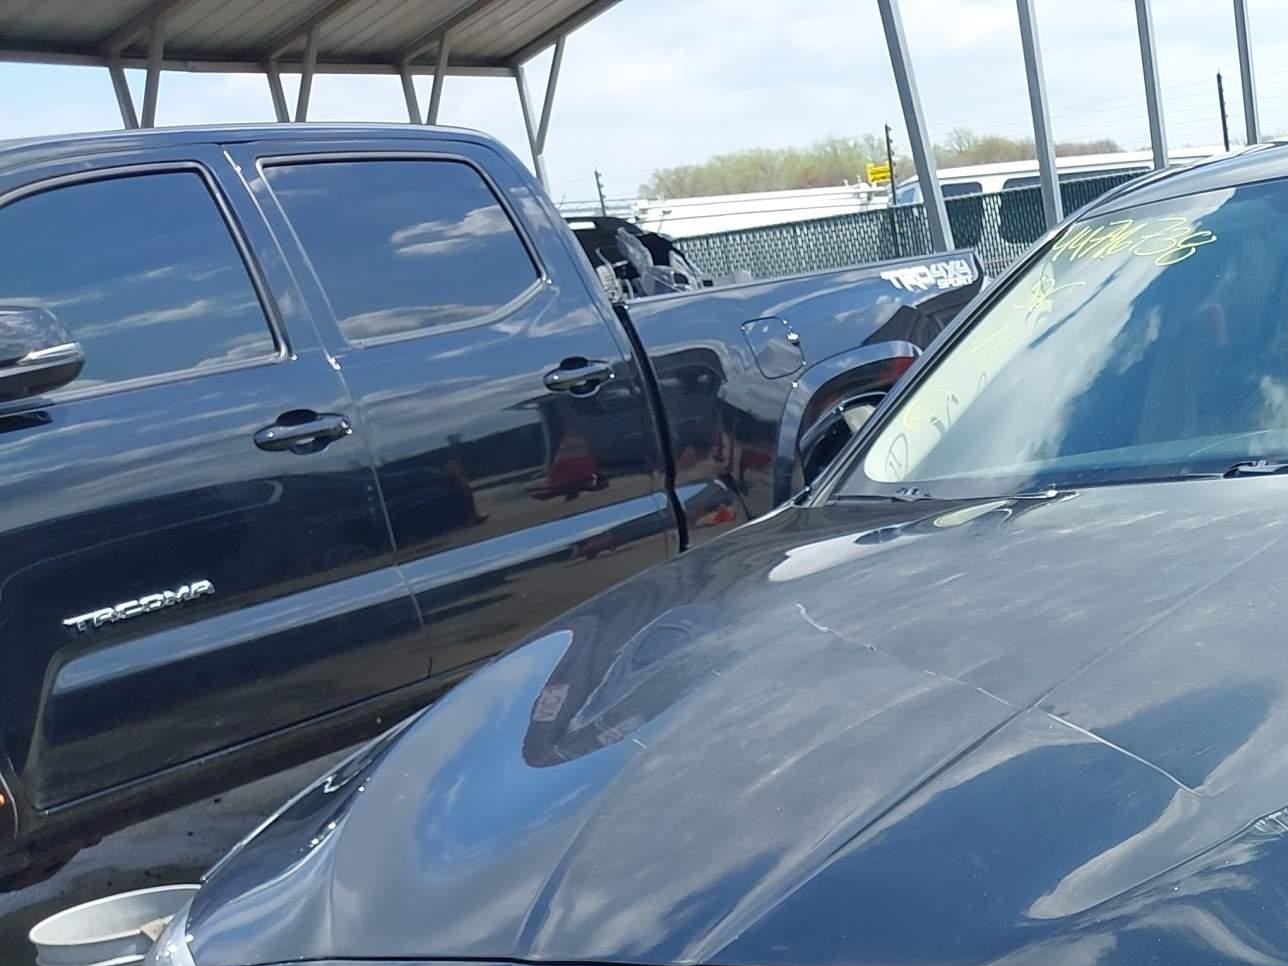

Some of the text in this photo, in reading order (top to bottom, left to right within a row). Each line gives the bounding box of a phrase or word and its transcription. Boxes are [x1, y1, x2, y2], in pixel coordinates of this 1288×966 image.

[880, 265, 935, 293] TRD
[936, 275, 975, 290] SPORT
[63, 579, 216, 632] TACOMA
